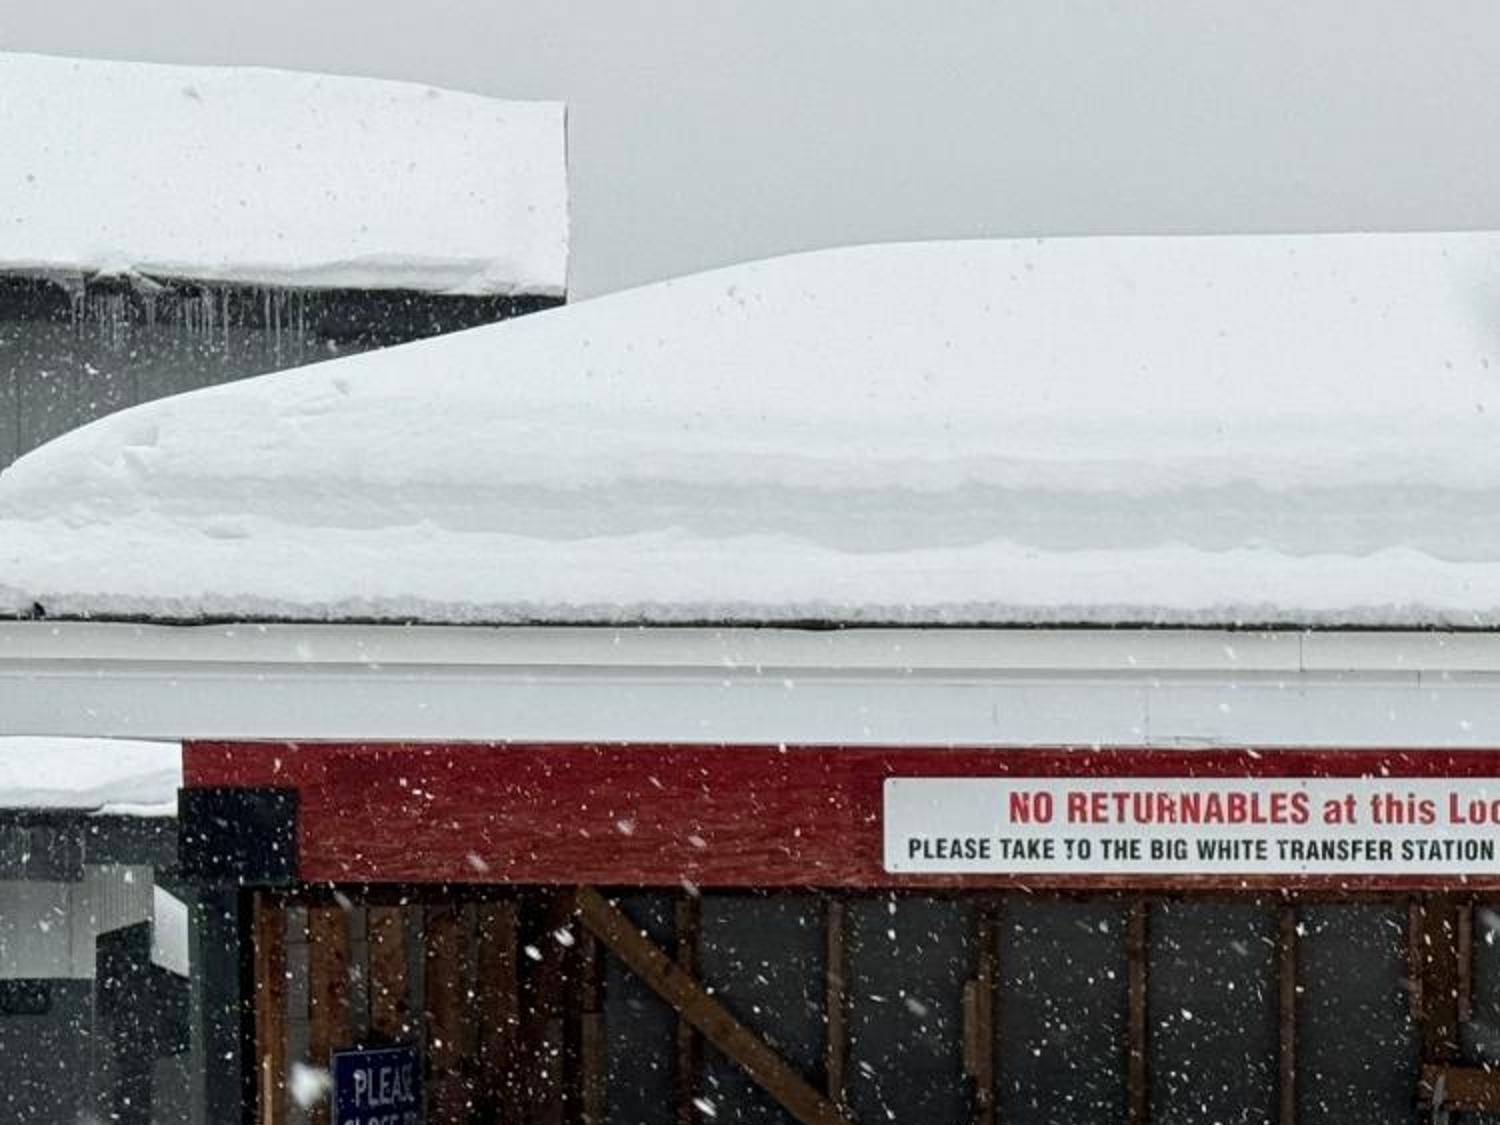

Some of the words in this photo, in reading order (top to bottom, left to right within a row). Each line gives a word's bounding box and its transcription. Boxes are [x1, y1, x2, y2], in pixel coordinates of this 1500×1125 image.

[1009, 792, 1053, 823] NO
[1067, 792, 1309, 824] RETURNABLES
[1324, 795, 1356, 823] at
[1371, 793, 1435, 823] this
[909, 838, 990, 859] PLEASE
[1000, 839, 1054, 859] TAKE
[1064, 839, 1090, 860] TO
[1101, 839, 1141, 860] THE
[1151, 839, 1187, 860] BIG
[1197, 840, 1267, 860] WHITE
[1277, 840, 1392, 861] TRANSFER
[1402, 840, 1493, 860] STATION
